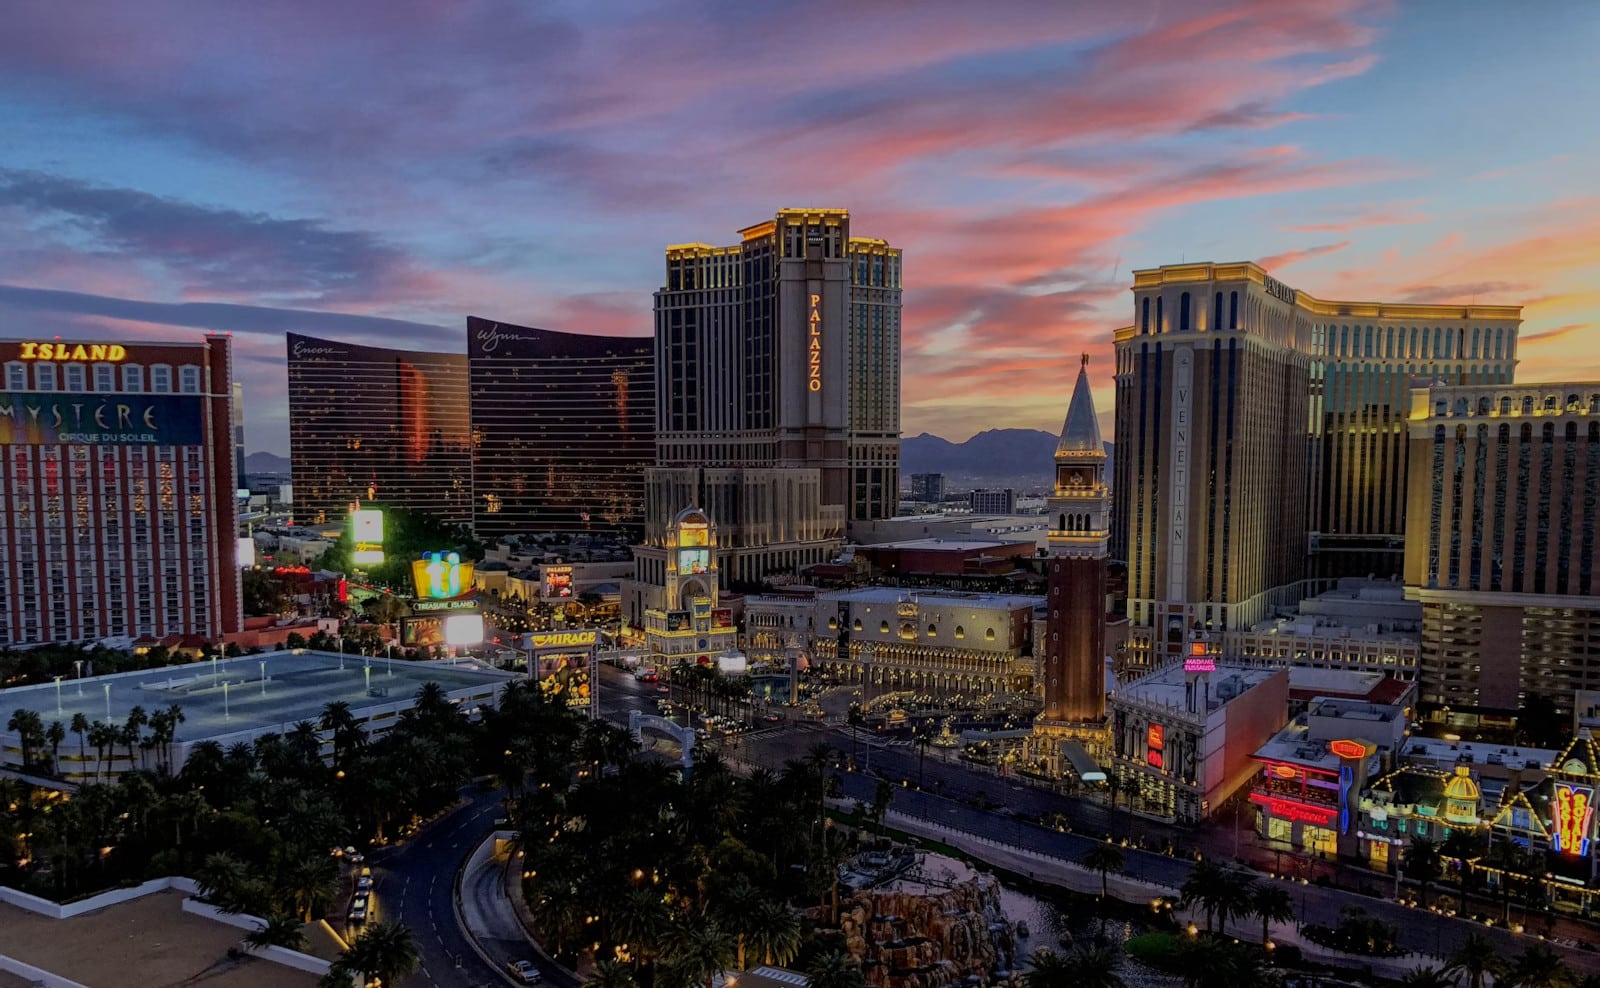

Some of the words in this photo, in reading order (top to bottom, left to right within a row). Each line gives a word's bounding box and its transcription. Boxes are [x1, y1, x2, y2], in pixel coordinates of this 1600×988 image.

[20, 342, 127, 361] ISLAND
[293, 341, 348, 357] Encore
[810, 294, 821, 392] PALAZZO
[58, 433, 100, 444] CIRQUE
[102, 434, 118, 442] DU
[120, 434, 158, 442] SOLEIL
[1174, 389, 1187, 541] VENETIAN
[426, 552, 460, 599] ti
[418, 602, 448, 610] TREASURE
[537, 631, 597, 646] MIRAGE
[1271, 802, 1329, 824] Walgreens
[1559, 787, 1571, 850] CASINO
[1570, 793, 1587, 855] ROYALE
